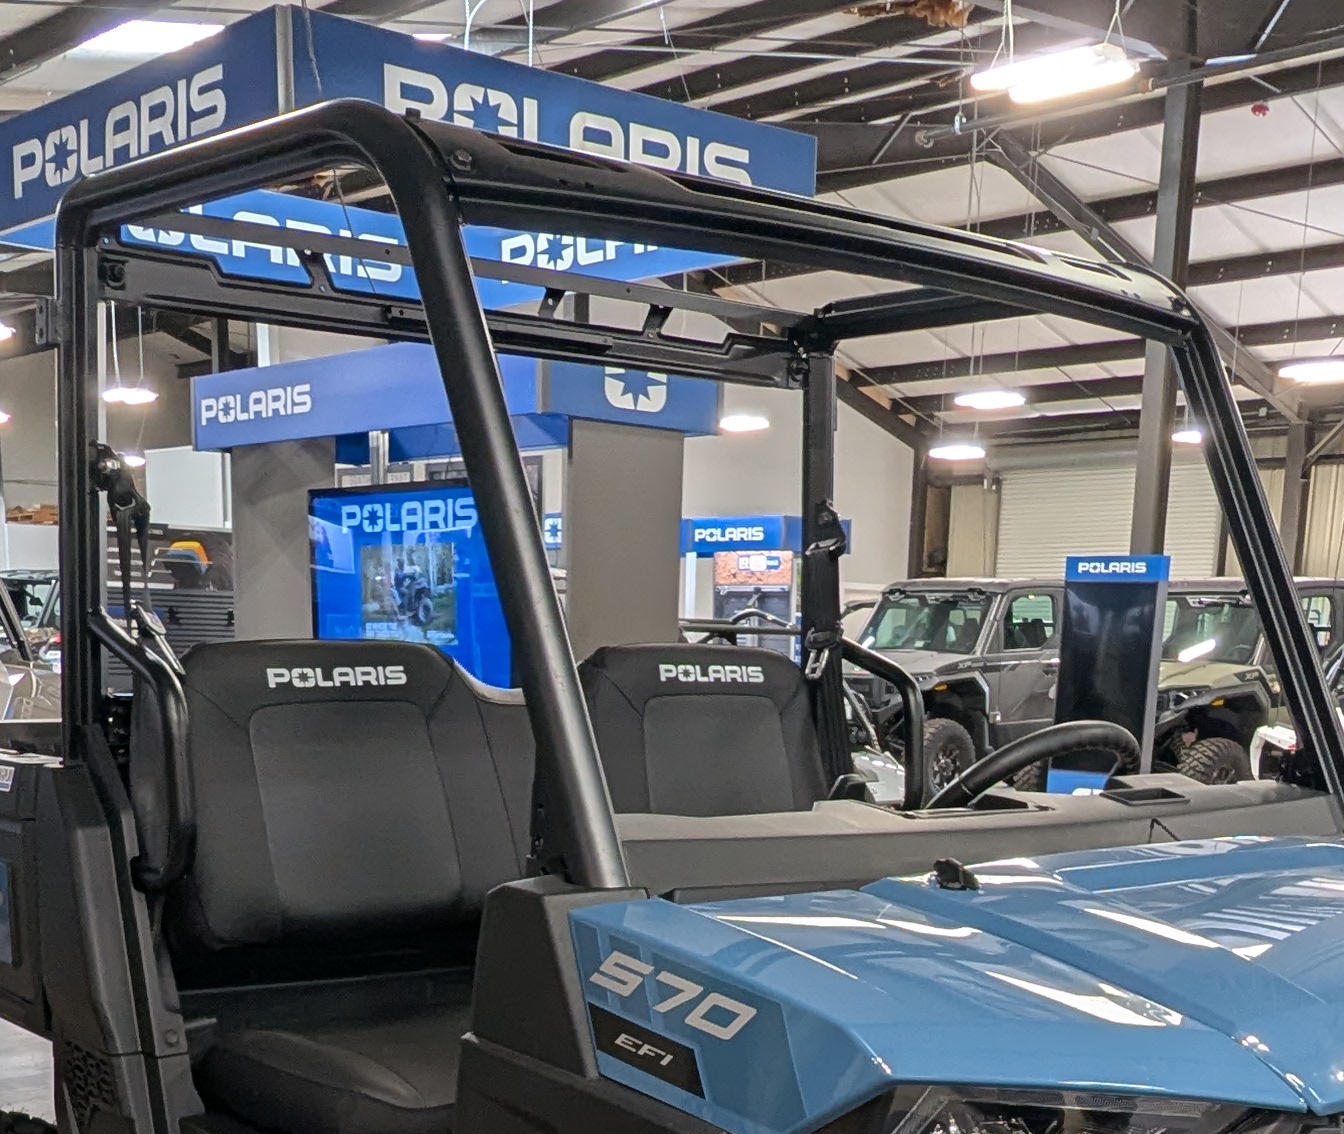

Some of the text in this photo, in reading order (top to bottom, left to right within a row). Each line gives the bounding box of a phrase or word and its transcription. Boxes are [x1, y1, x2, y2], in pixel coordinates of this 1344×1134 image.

[12, 63, 227, 199] POLARIS
[201, 383, 312, 426] POLARIS
[342, 497, 479, 533] POLARIS
[694, 527, 765, 542] POLARIS
[1078, 562, 1147, 573] POLARIS
[266, 665, 408, 688] POLARIS
[659, 664, 765, 683] POLARIS
[613, 1033, 674, 1067] EFI
